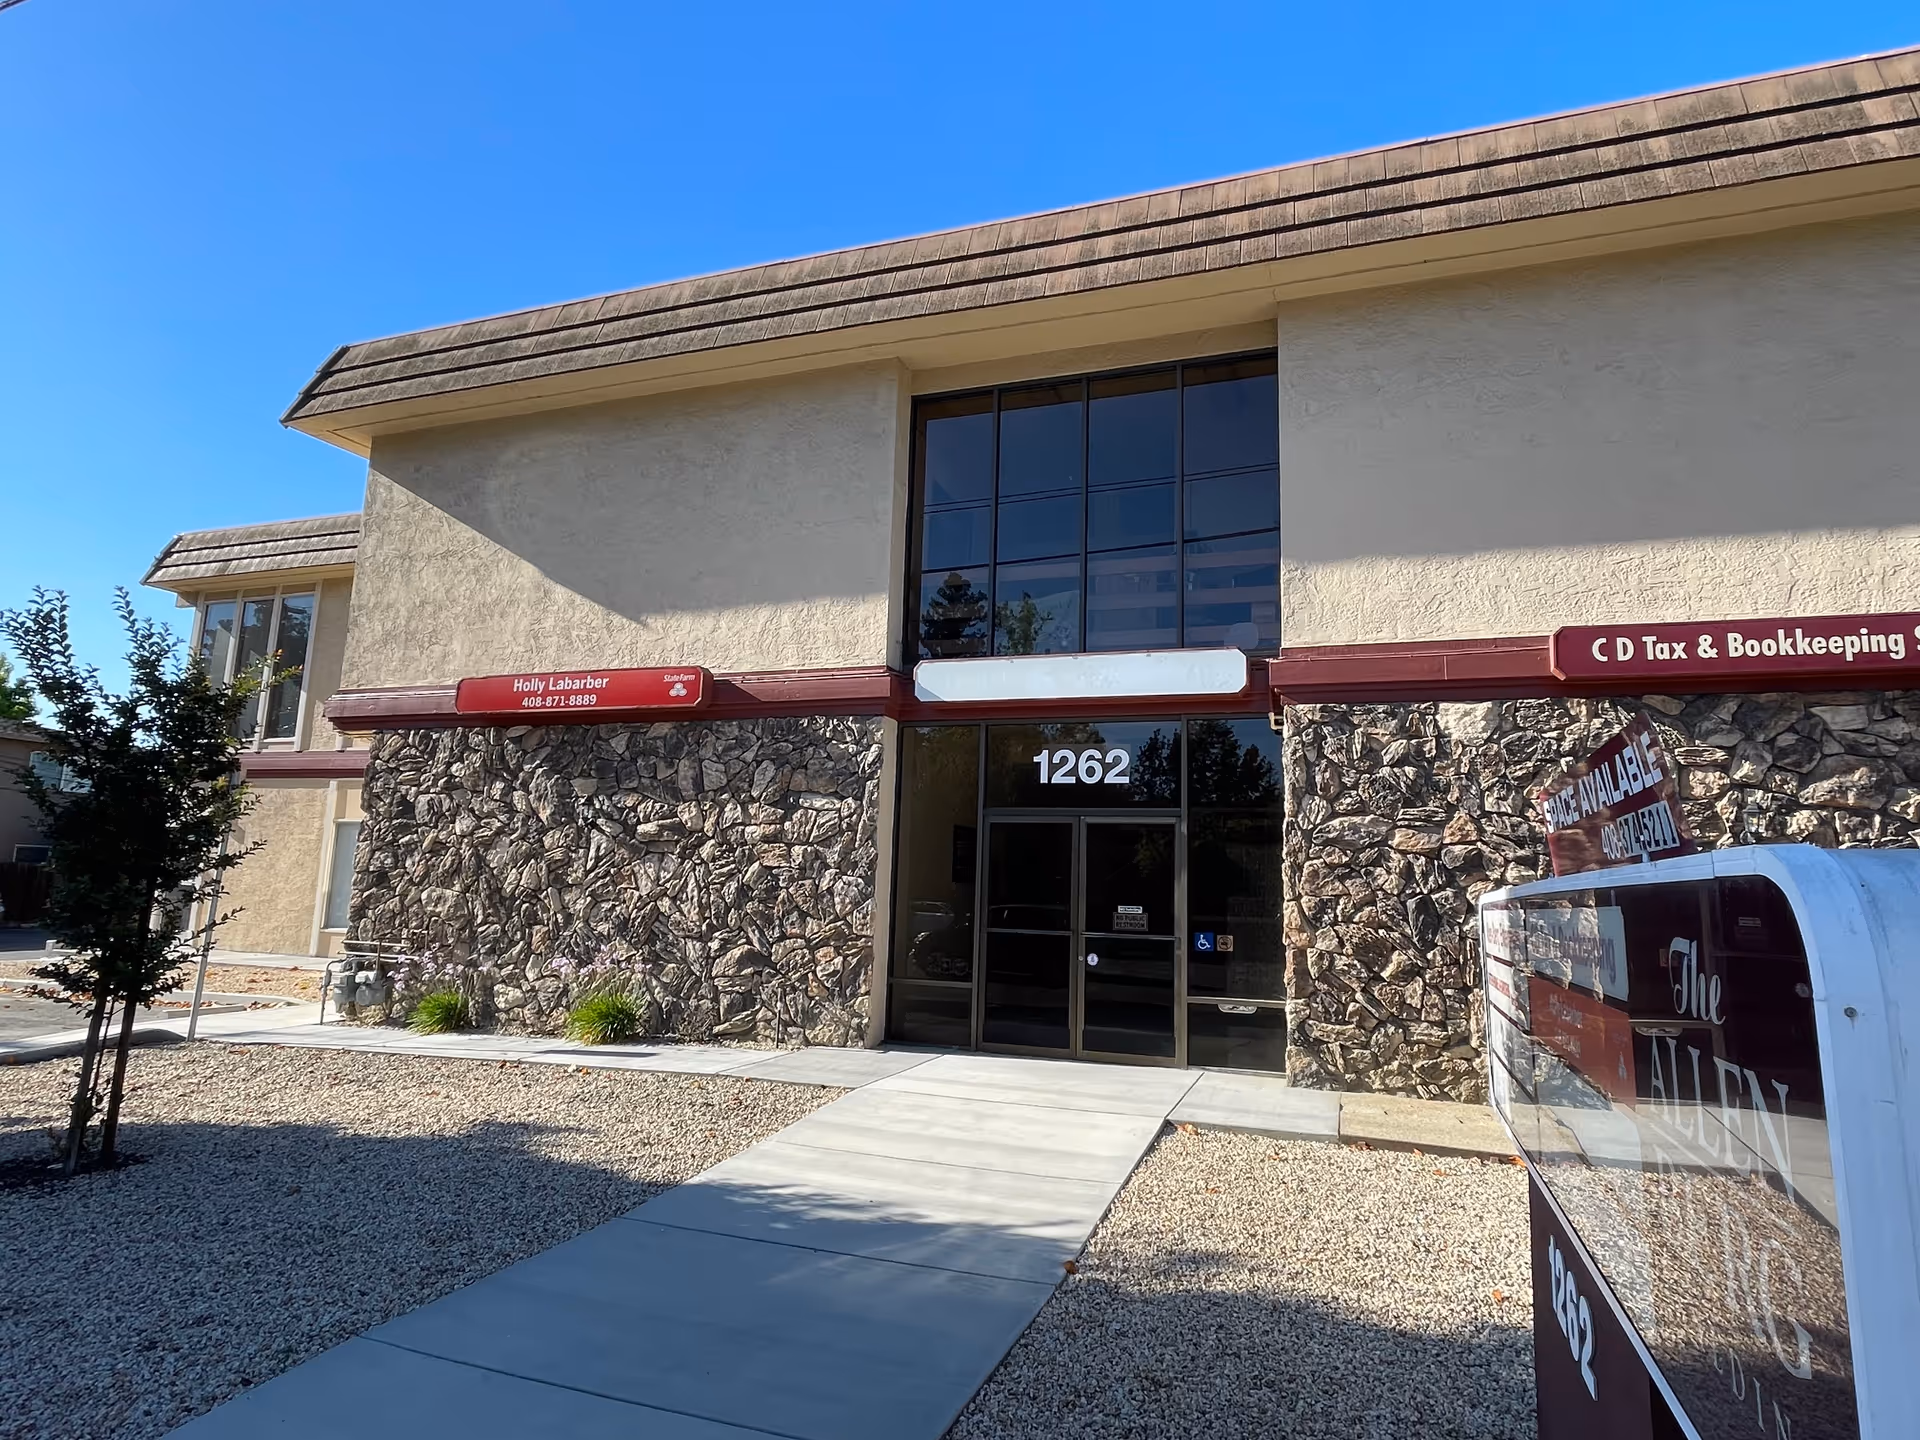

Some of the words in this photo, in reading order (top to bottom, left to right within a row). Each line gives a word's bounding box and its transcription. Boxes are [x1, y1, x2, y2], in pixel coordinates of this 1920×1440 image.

[1592, 638, 1608, 662] C
[1617, 637, 1634, 661] D
[1642, 635, 1688, 661] Tax
[1697, 634, 1719, 659] &
[1727, 628, 1906, 661] Bookkeeping
[513, 677, 546, 695] Holly
[548, 674, 610, 692] Labarber
[522, 694, 597, 708] 408-871-8889
[1033, 748, 1130, 785] 1262
[1543, 785, 1581, 834] SPACE
[1578, 730, 1664, 818] AVAILABLE
[1669, 936, 1726, 1026] The
[1650, 1031, 1796, 1204] ALLEN
[1549, 1235, 1598, 1401] 1262
